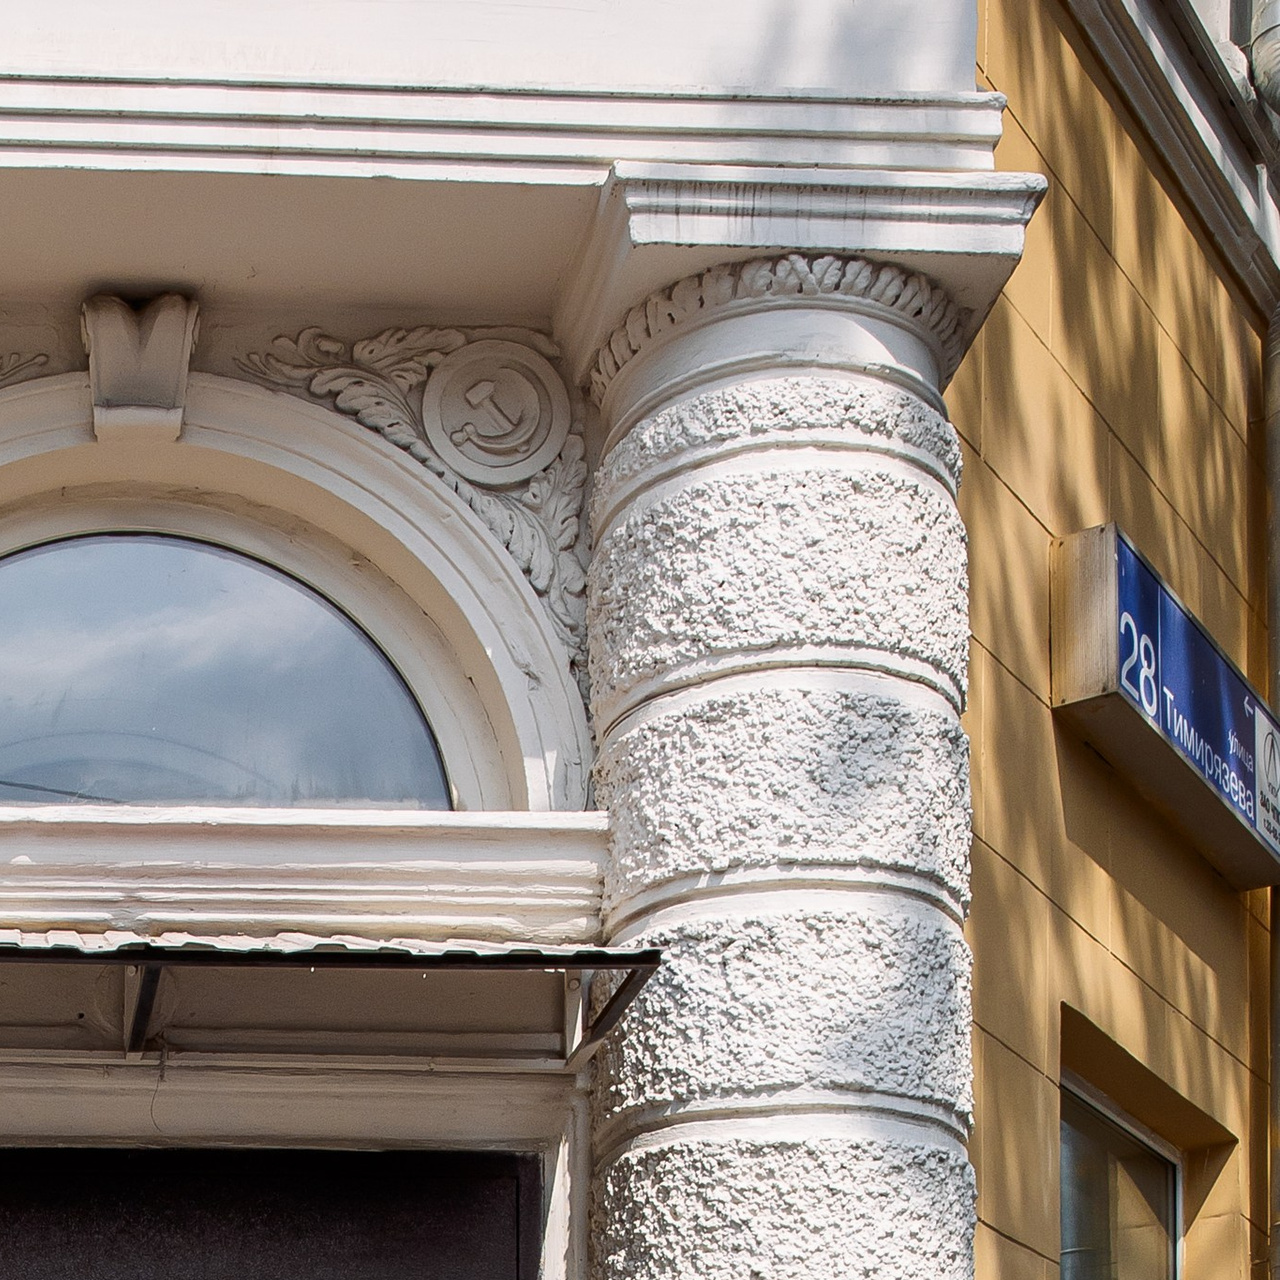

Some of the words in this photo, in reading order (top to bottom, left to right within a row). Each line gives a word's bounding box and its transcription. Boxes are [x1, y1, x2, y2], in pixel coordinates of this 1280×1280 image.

[1120, 611, 1158, 718] 28
[1162, 685, 1255, 821] Тимирязева
[1228, 728, 1254, 774] улица
